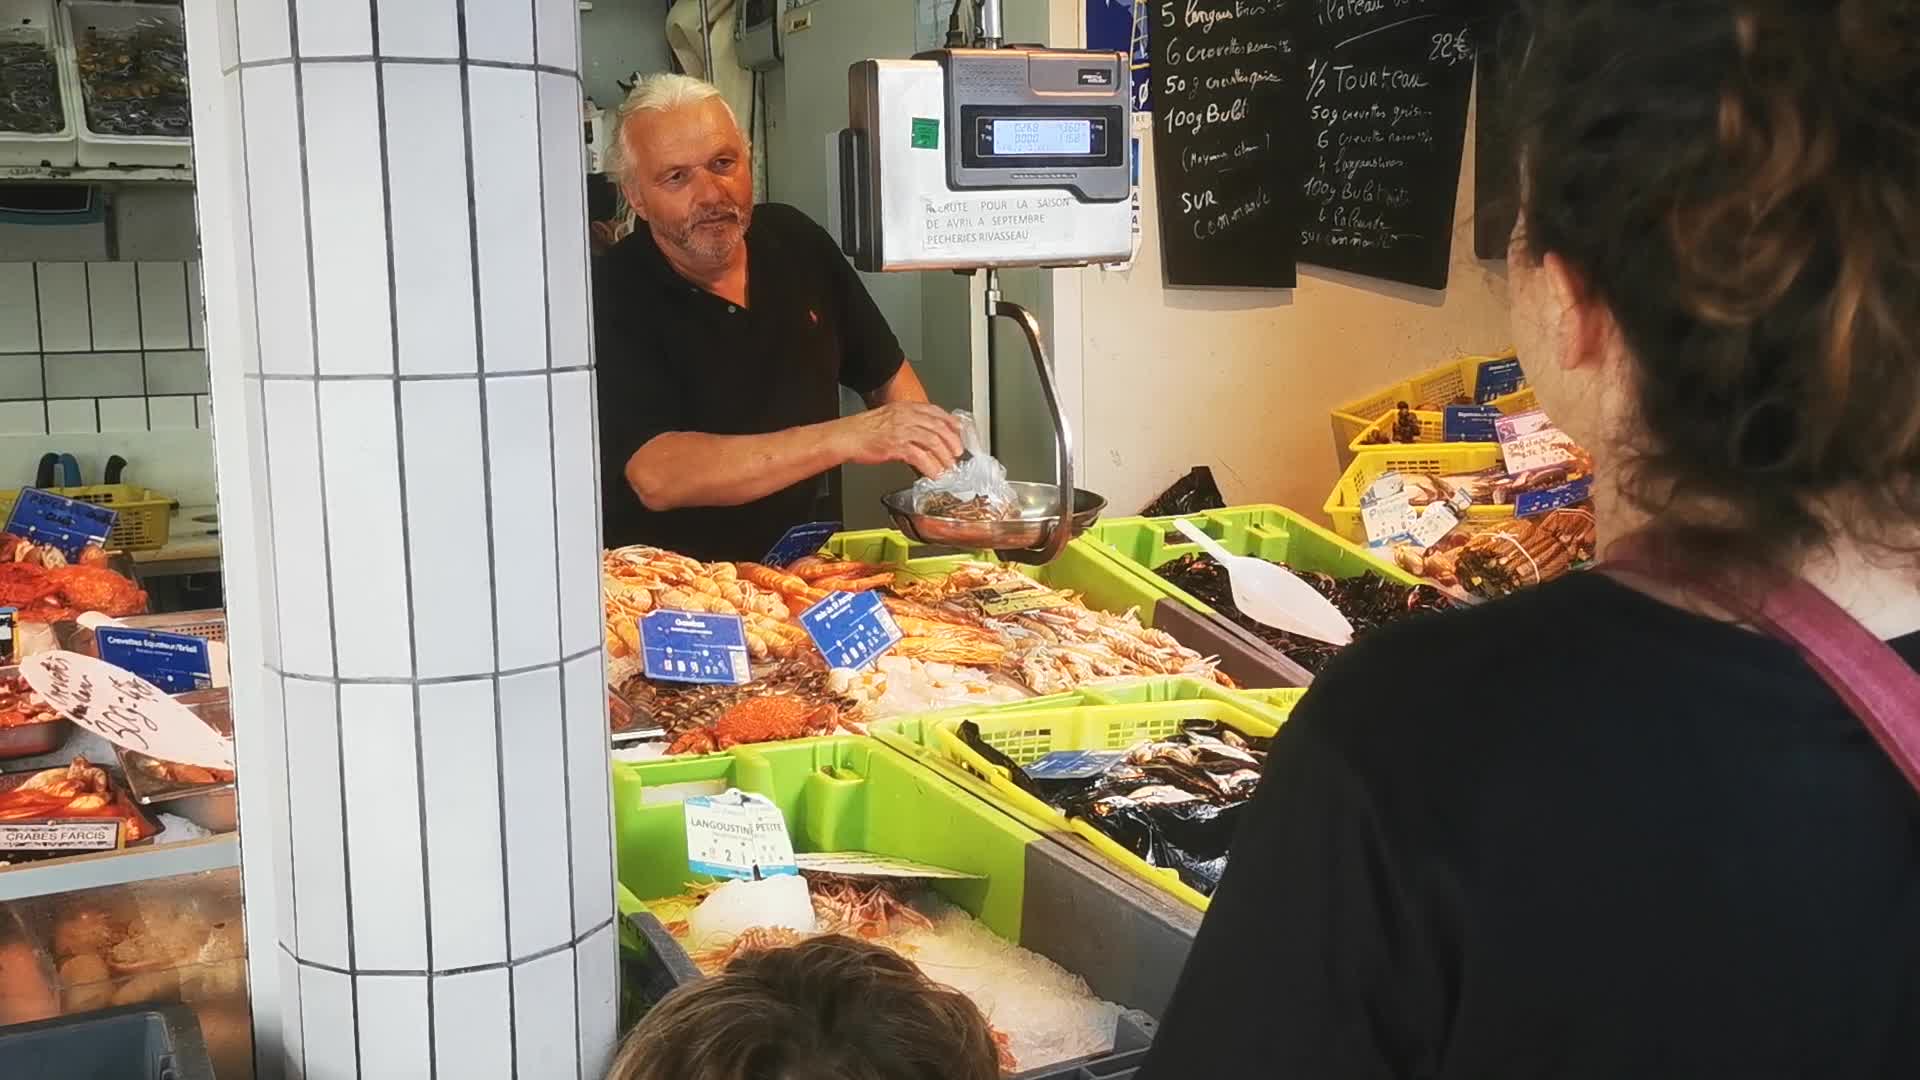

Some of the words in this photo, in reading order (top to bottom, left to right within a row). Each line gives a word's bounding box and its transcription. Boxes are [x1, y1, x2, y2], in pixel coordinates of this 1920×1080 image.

[1161, 2, 1176, 28] 5
[1166, 37, 1181, 66] 6
[1318, 129, 1329, 149] 6
[980, 200, 1008, 211] POUR
[1016, 198, 1029, 209] LA
[1037, 196, 1071, 208] SAISON
[1181, 190, 1219, 214] SUR
[926, 218, 940, 230] DE
[946, 217, 973, 229] AVRIL
[991, 213, 1046, 226] SEPTEMBRE
[979, 231, 1029, 242] RIVASSEAU
[6, 831, 57, 842] CRABES
[60, 830, 106, 841] FARCIS
